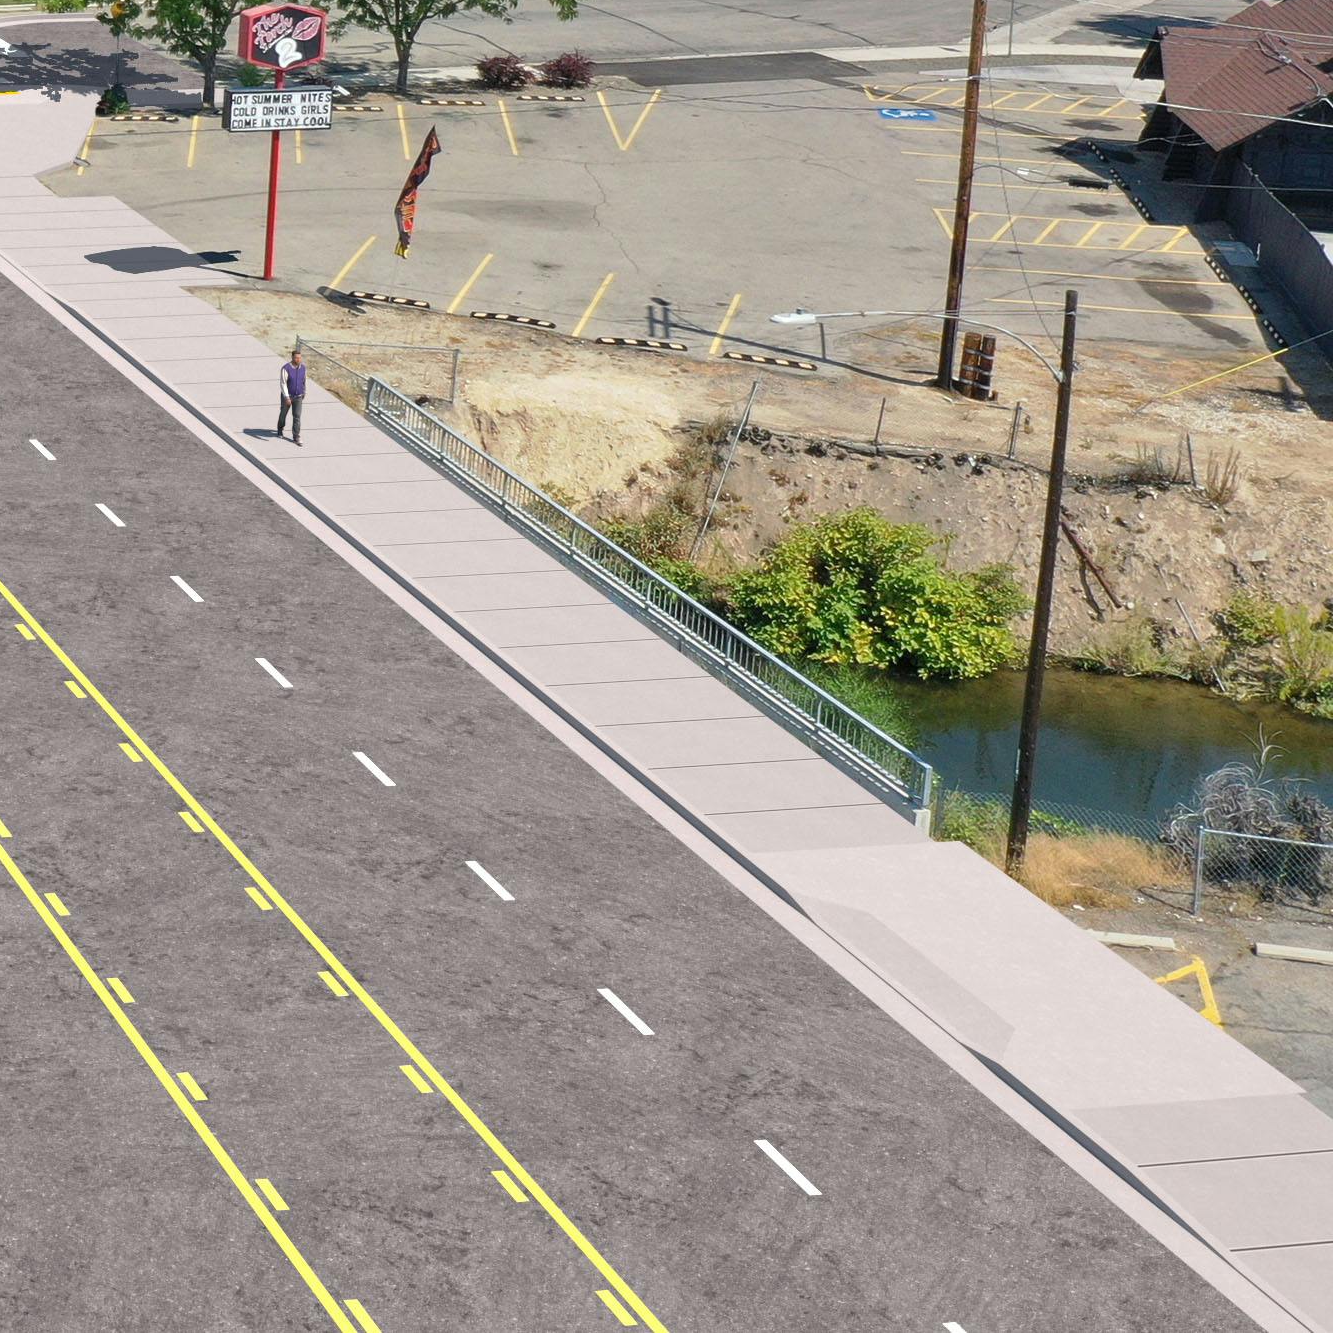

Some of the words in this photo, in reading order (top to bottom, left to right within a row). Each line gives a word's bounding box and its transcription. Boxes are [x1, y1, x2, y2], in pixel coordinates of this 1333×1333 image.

[275, 37, 303, 68] 2
[231, 95, 248, 105] HOT
[251, 94, 293, 105] SUMMER
[300, 92, 331, 103] NITES
[233, 107, 257, 117] COLD
[262, 106, 296, 116] DRINKS
[301, 104, 329, 115] GIRLS
[232, 119, 257, 129] COME
[261, 118, 272, 128] IN
[274, 117, 299, 128] STAY
[303, 116, 329, 126] COOL
